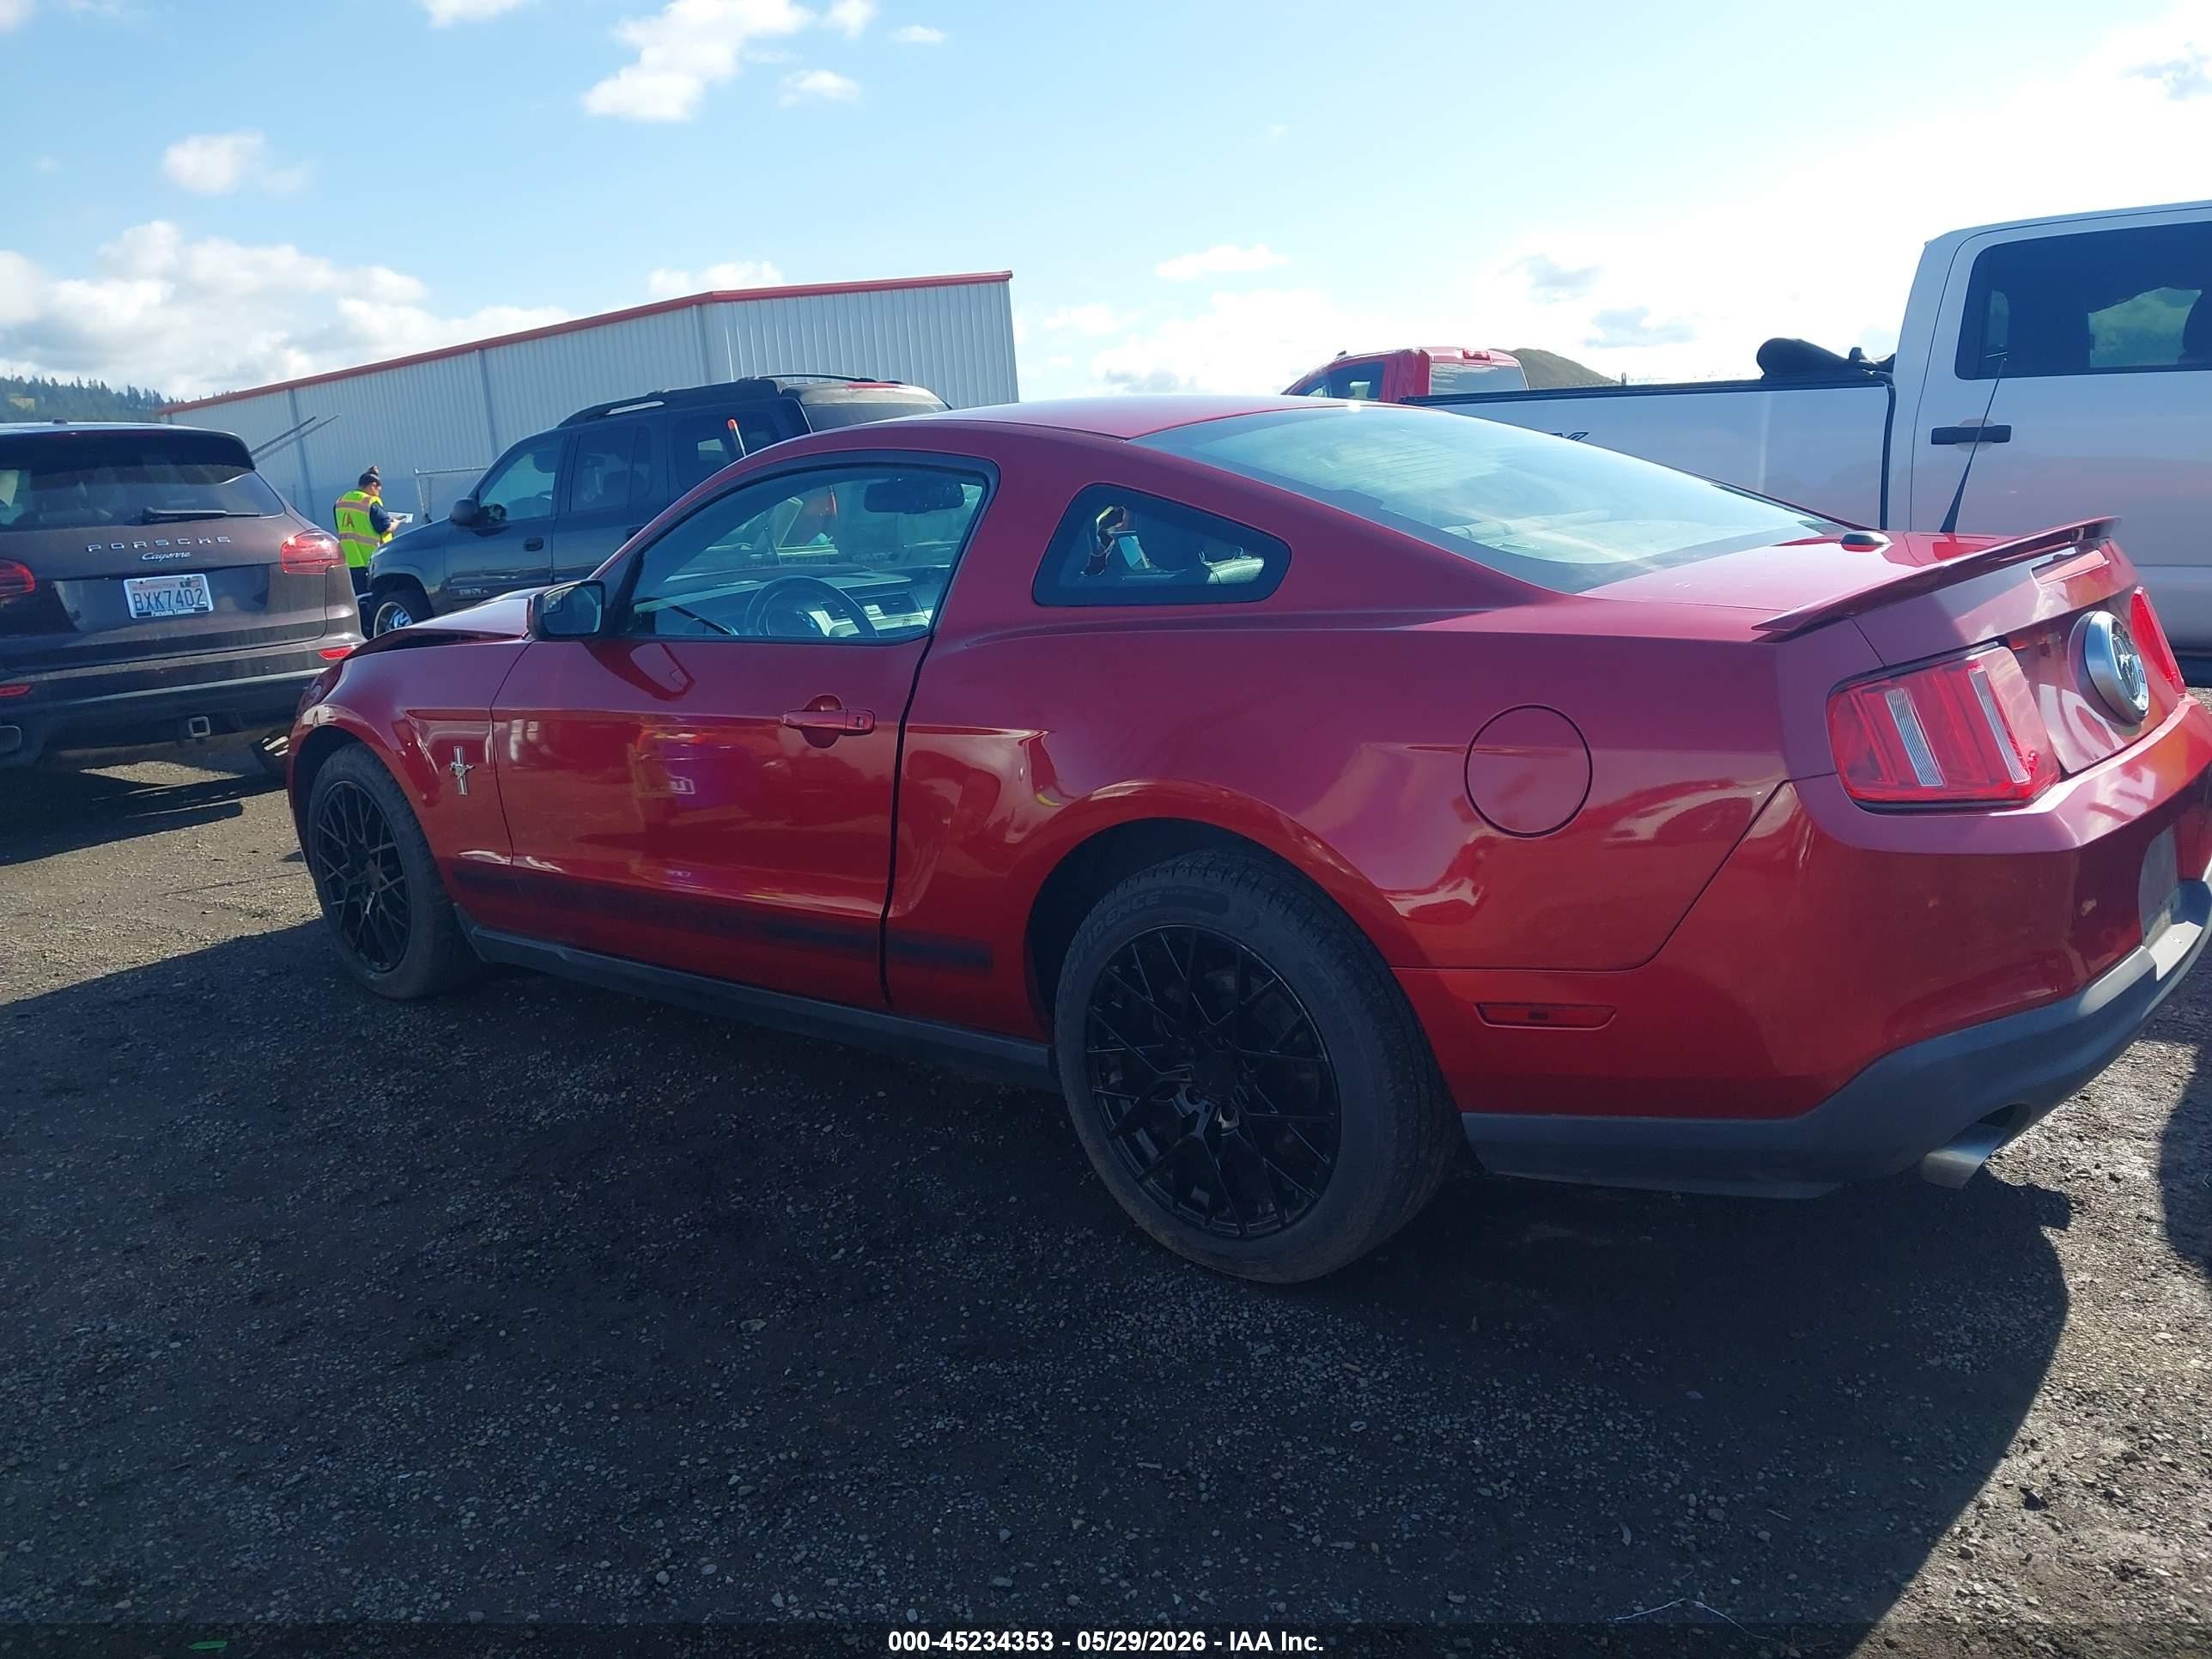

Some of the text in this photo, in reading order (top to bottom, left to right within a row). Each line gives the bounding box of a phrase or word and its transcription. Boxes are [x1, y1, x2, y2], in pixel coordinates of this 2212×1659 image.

[86, 536, 231, 552] PORSCHE
[142, 551, 192, 562] Cayenne
[132, 588, 207, 611] BXK7402
